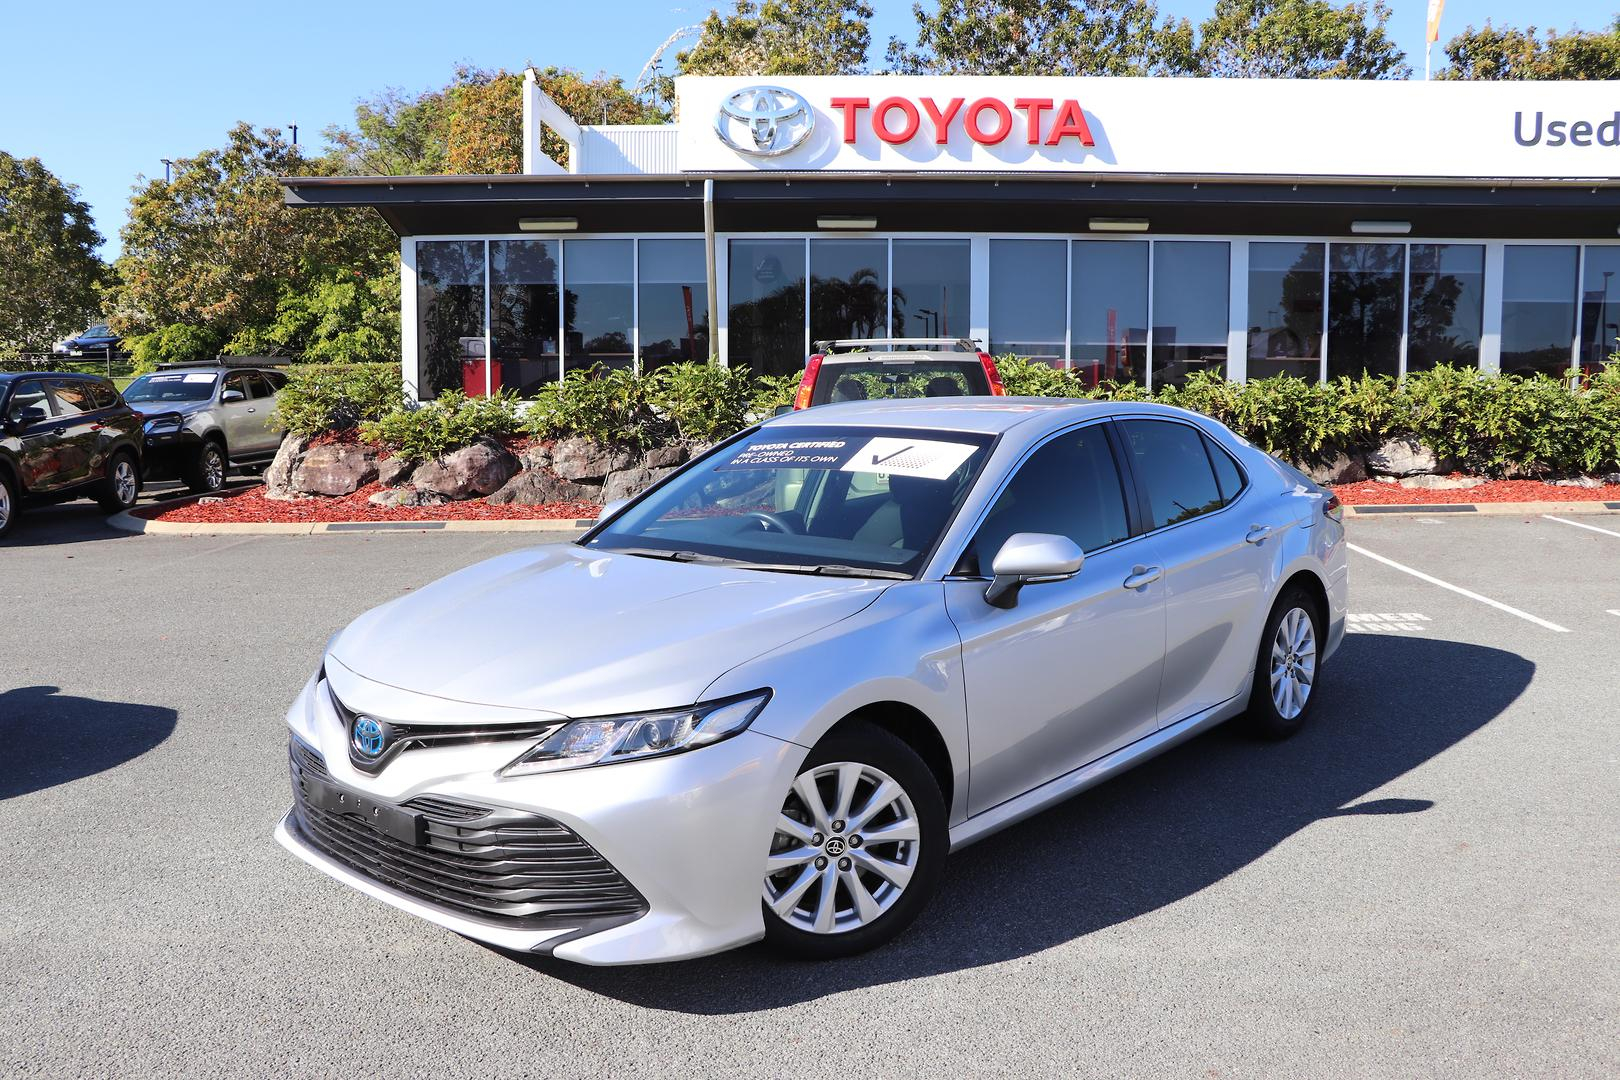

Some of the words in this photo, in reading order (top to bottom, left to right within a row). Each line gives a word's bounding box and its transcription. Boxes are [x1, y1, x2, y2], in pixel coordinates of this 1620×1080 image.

[830, 96, 1095, 147] TOYOTA
[1514, 111, 1620, 147] Used
[748, 443, 788, 451] TOYOTA
[789, 441, 846, 449] CERTIFIED
[737, 450, 794, 459] PRE-OWNED
[810, 455, 839, 463] OWN
